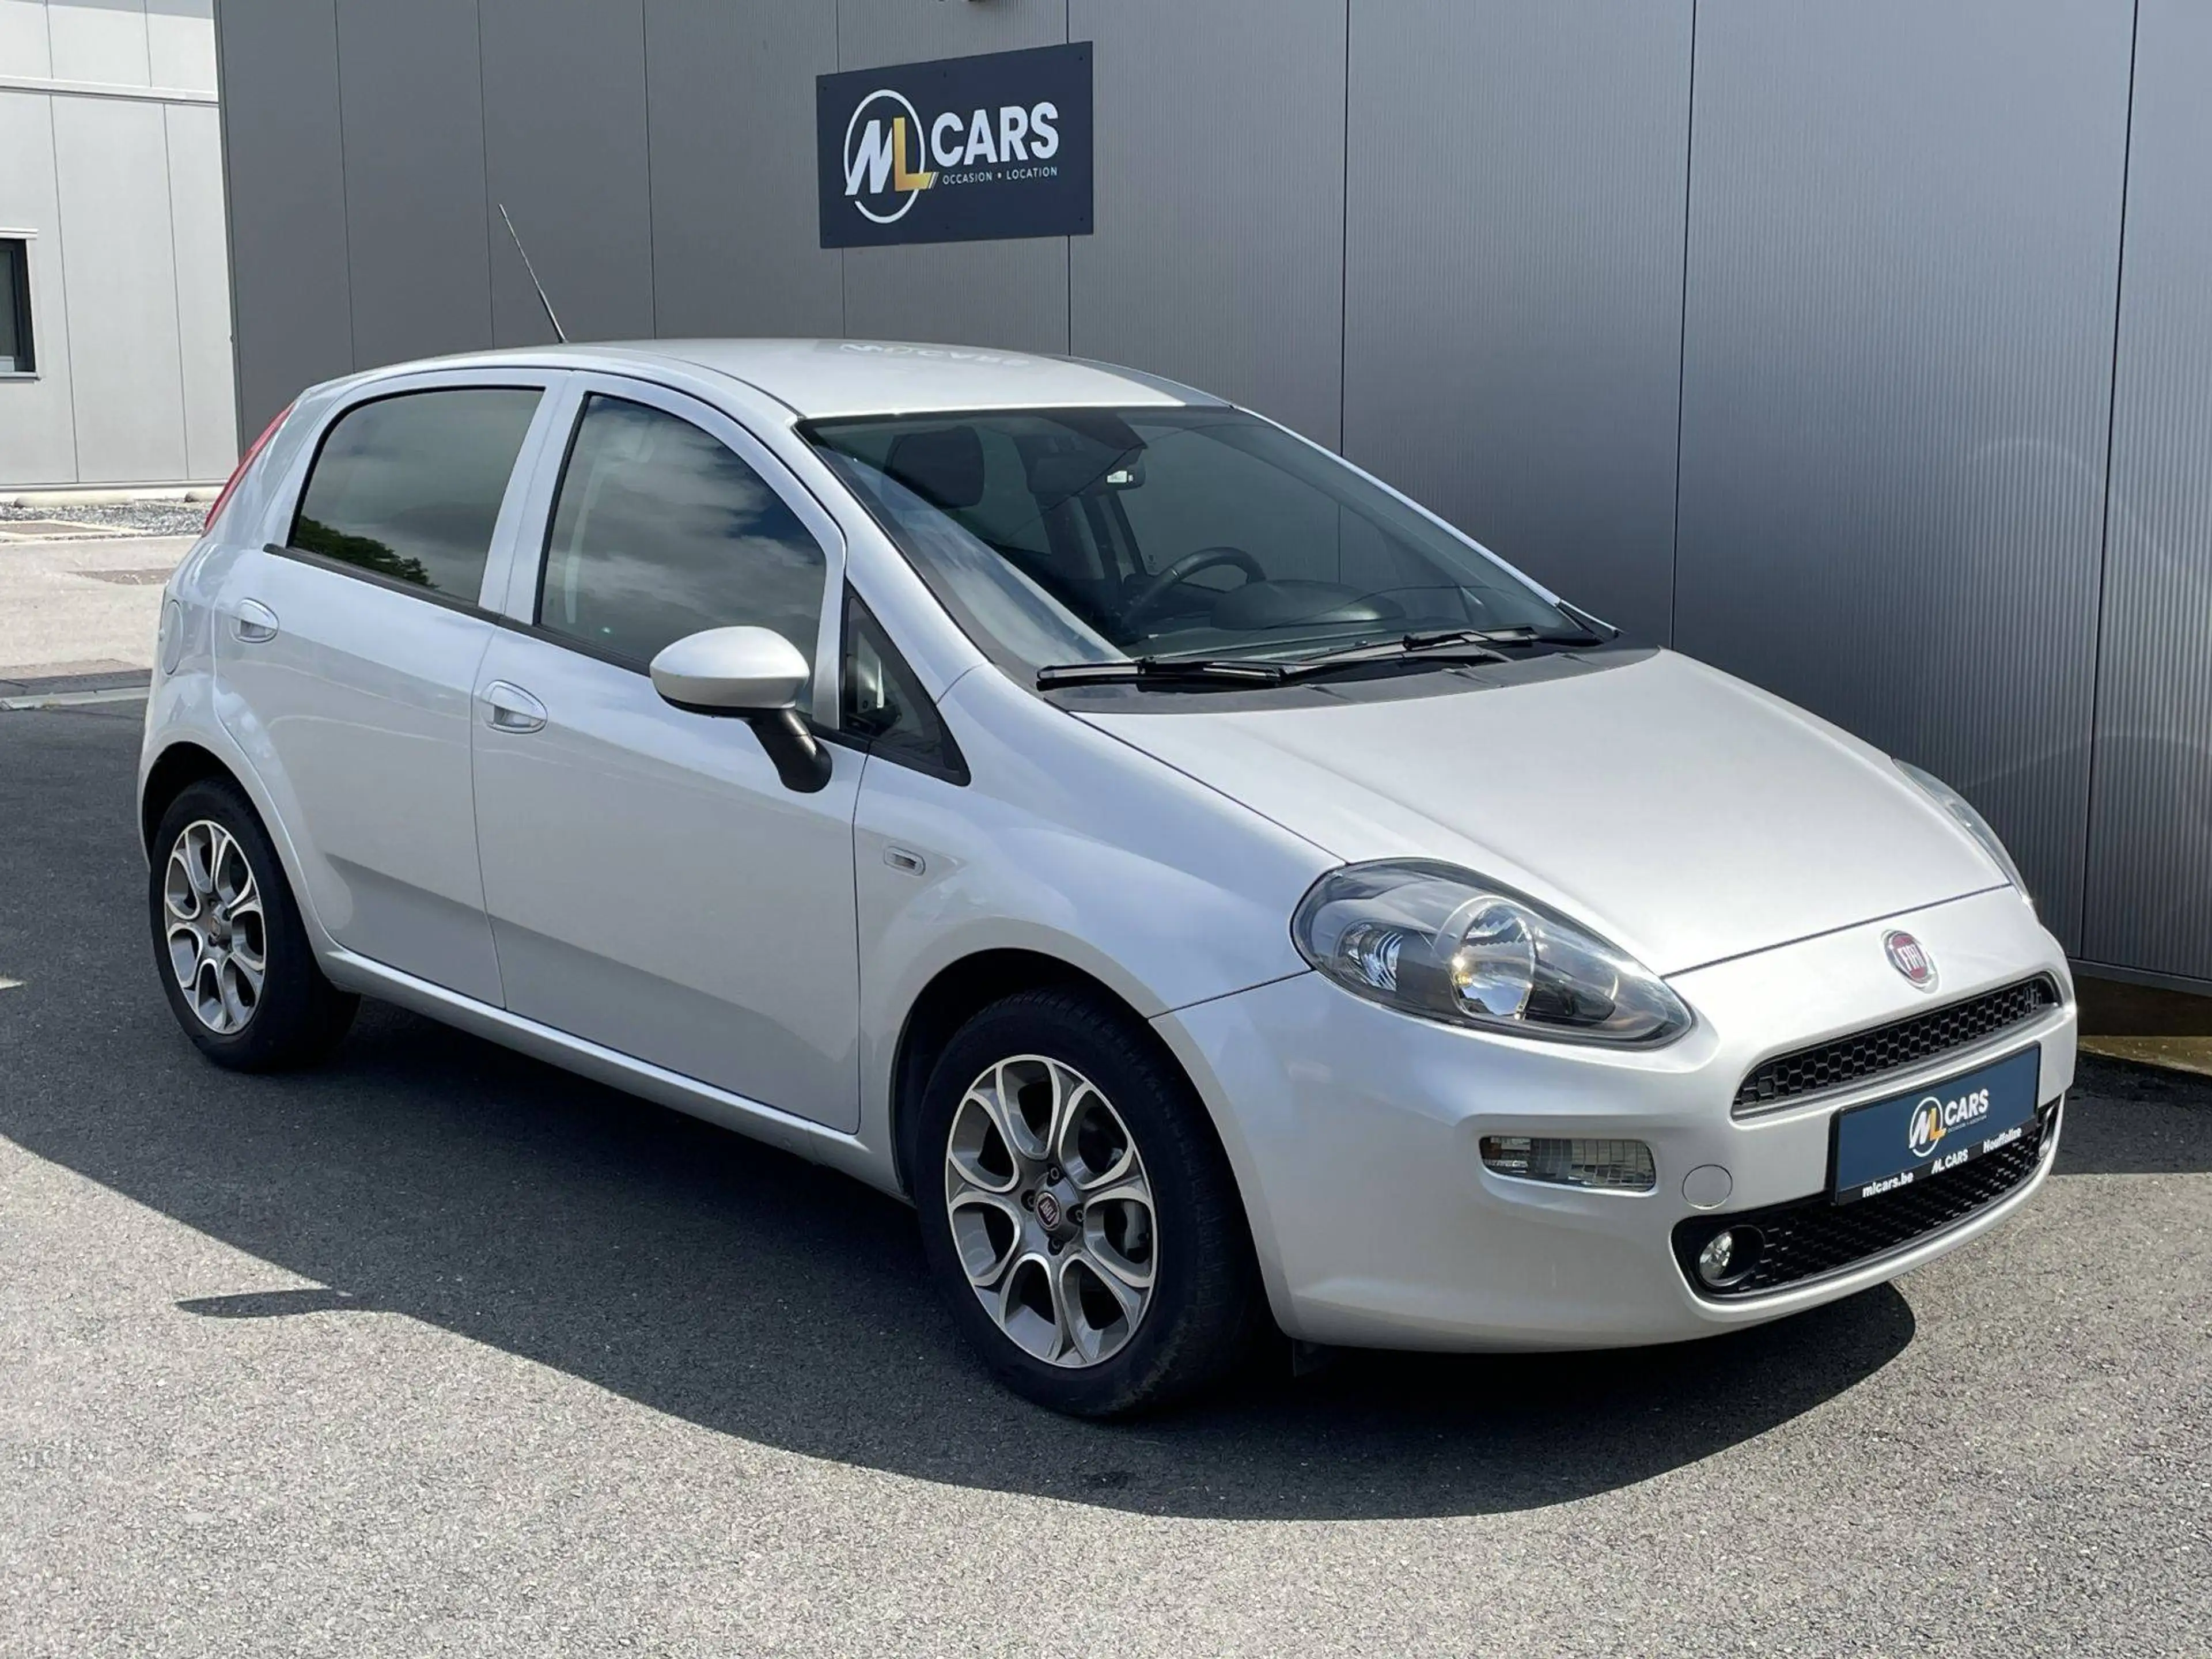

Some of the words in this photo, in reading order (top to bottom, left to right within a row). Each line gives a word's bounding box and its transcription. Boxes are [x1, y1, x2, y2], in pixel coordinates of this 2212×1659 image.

[844, 116, 939, 196] ML
[930, 101, 1059, 167] CARS
[942, 171, 993, 184] OCCASION
[1006, 166, 1058, 180] LOCATION
[1909, 1107, 1946, 1149] ML
[1944, 1088, 1988, 1126] CARS
[1862, 1172, 1914, 1198] mlcars.be
[1945, 1149, 1968, 1168] CARS
